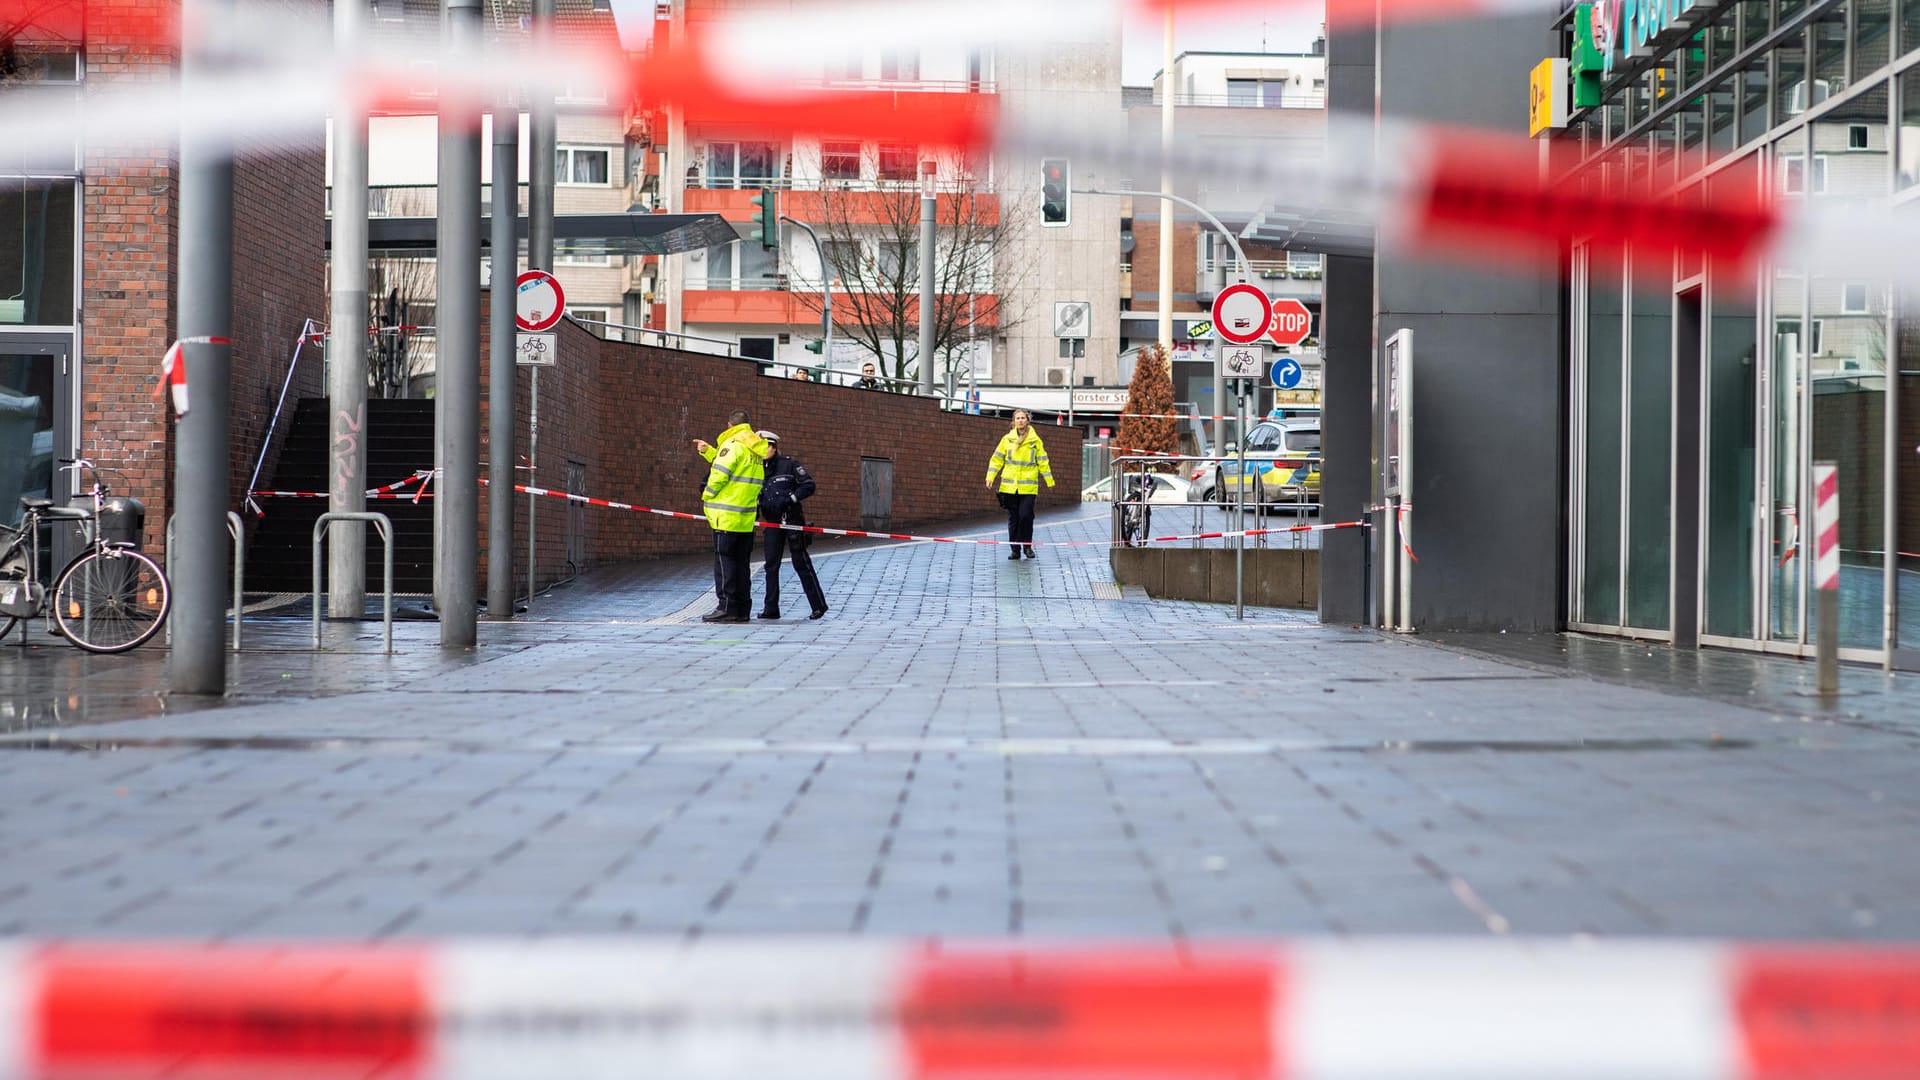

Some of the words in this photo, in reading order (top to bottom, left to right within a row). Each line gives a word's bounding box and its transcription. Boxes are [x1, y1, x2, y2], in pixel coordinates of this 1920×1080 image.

[1189, 322, 1211, 337] TAXI
[1269, 313, 1306, 332] STOP
[1073, 394, 1109, 402] Horster
